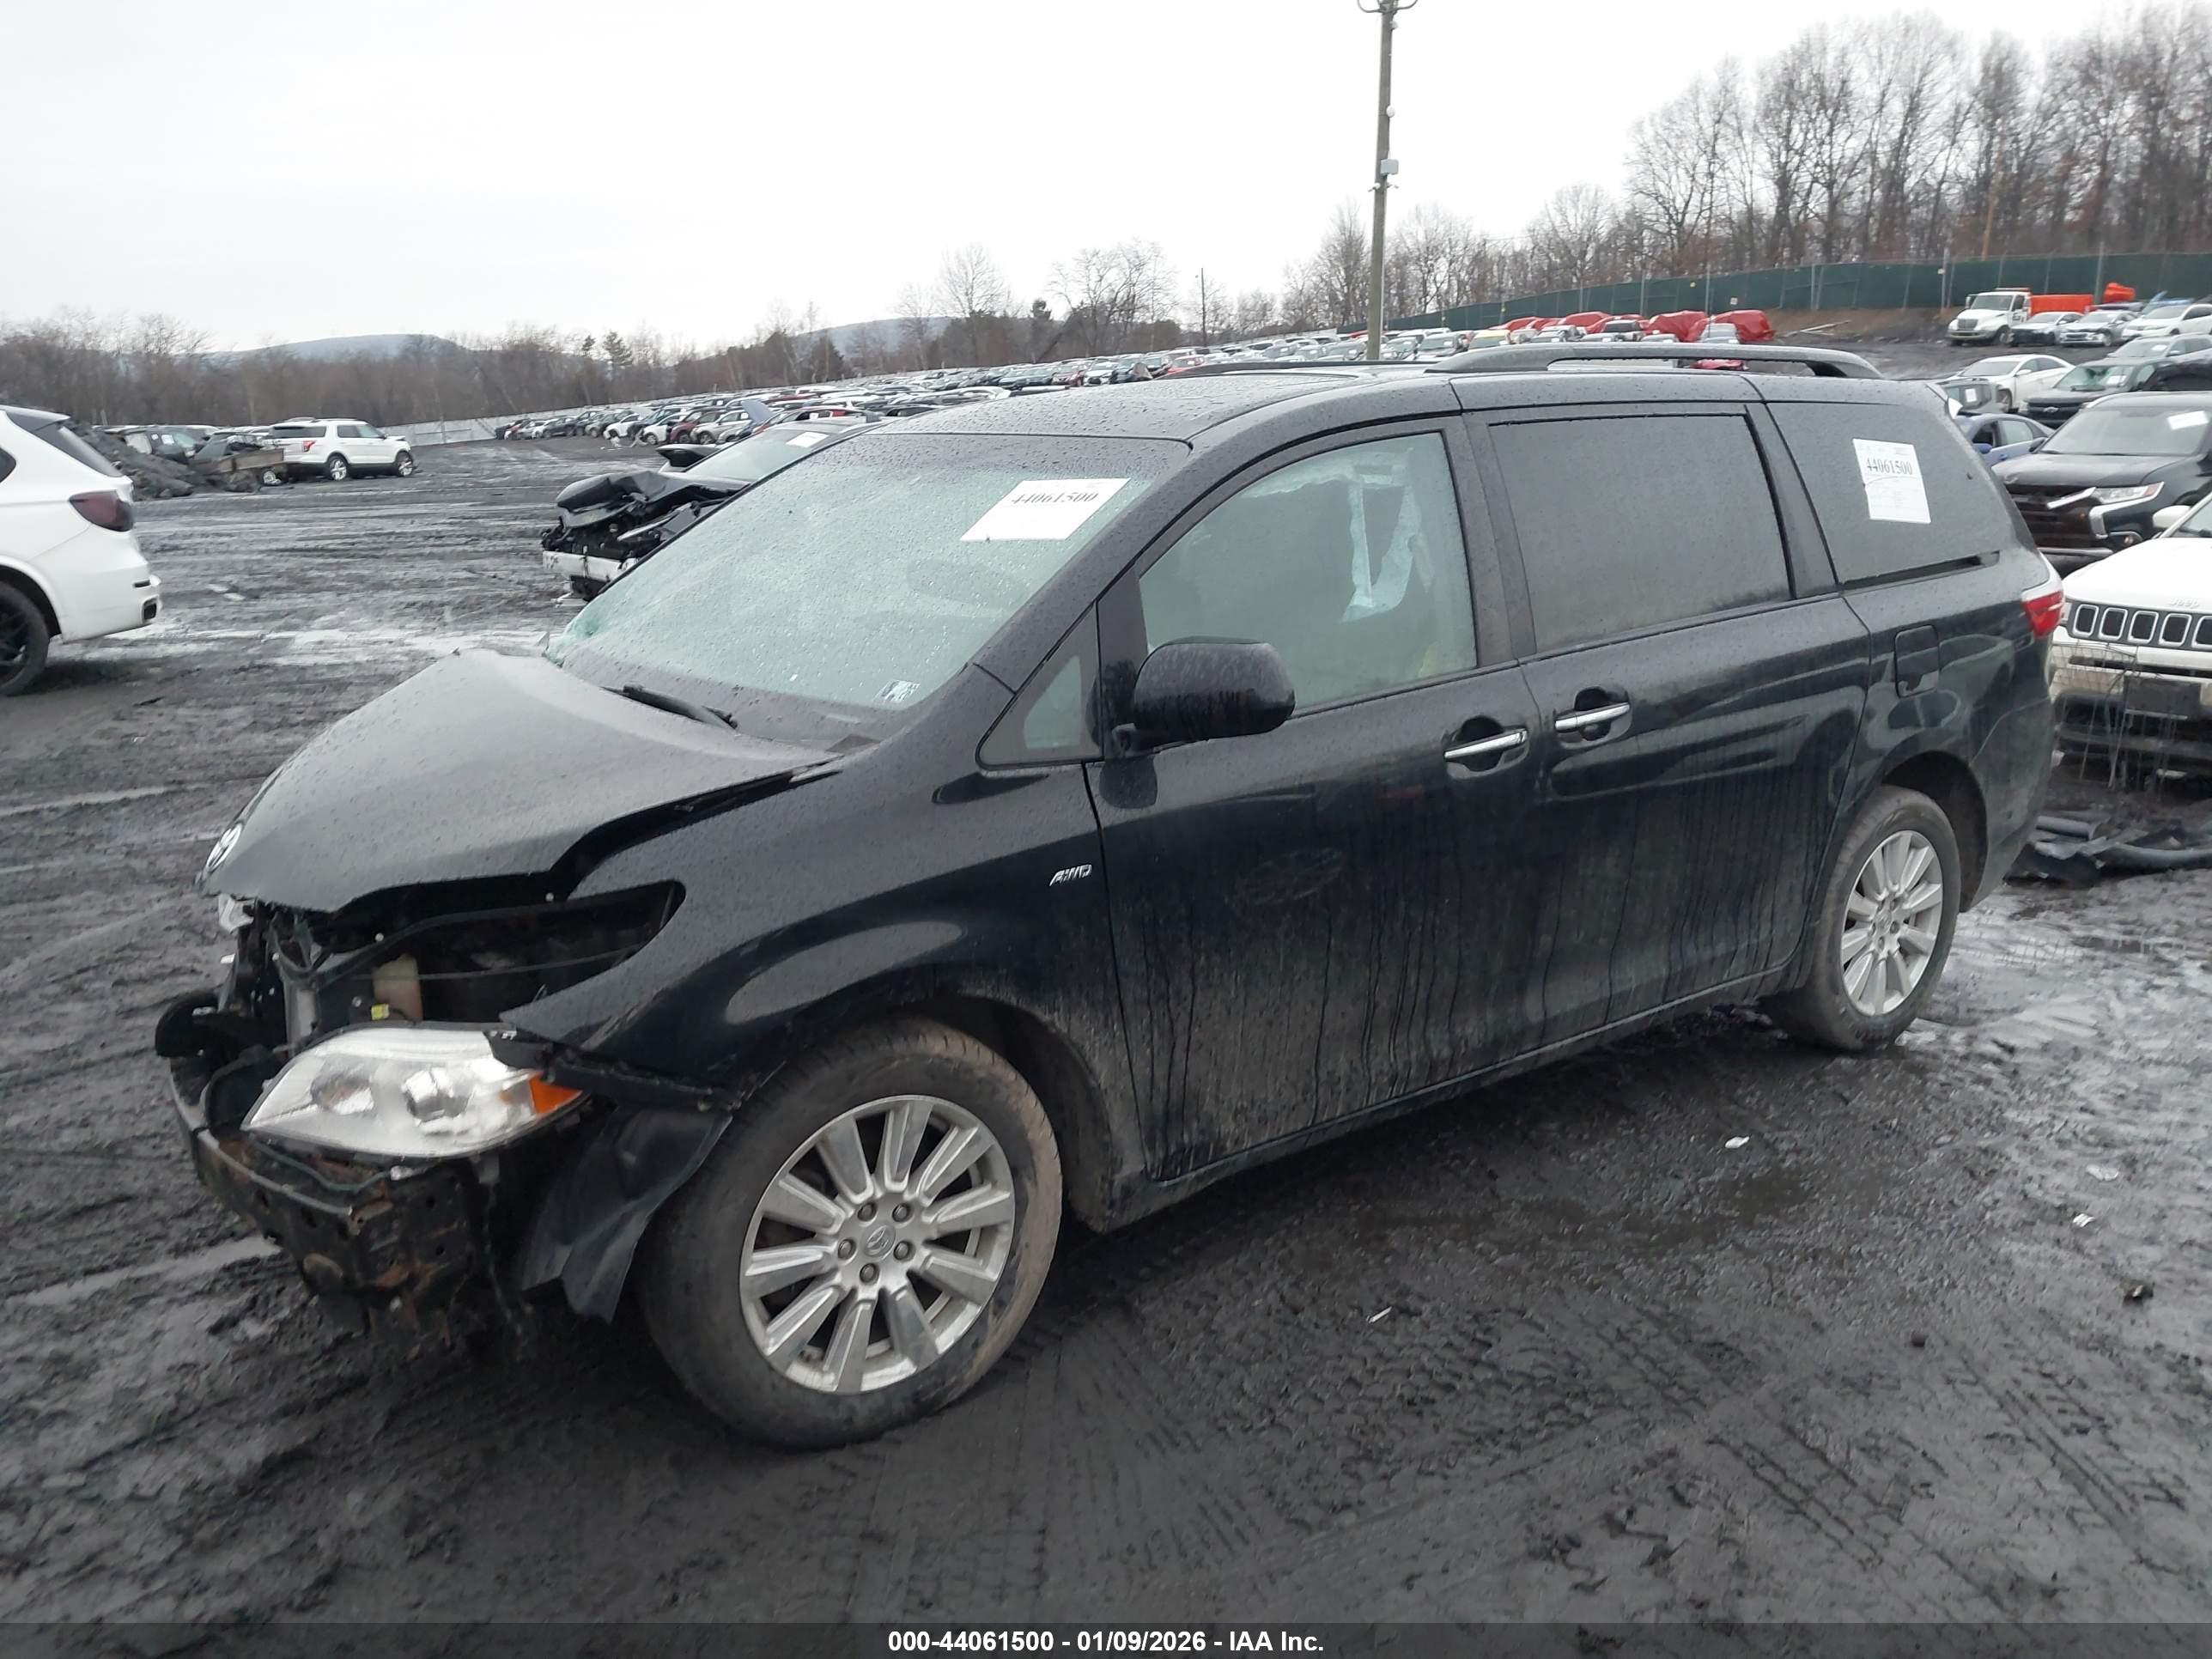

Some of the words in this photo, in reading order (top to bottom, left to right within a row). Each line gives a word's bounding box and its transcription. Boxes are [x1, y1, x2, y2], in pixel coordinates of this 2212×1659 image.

[1866, 457, 1913, 475] 44061500
[1011, 491, 1099, 504] 44061500
[2170, 597, 2199, 609] Jeep
[1048, 864, 1093, 887] AWD
